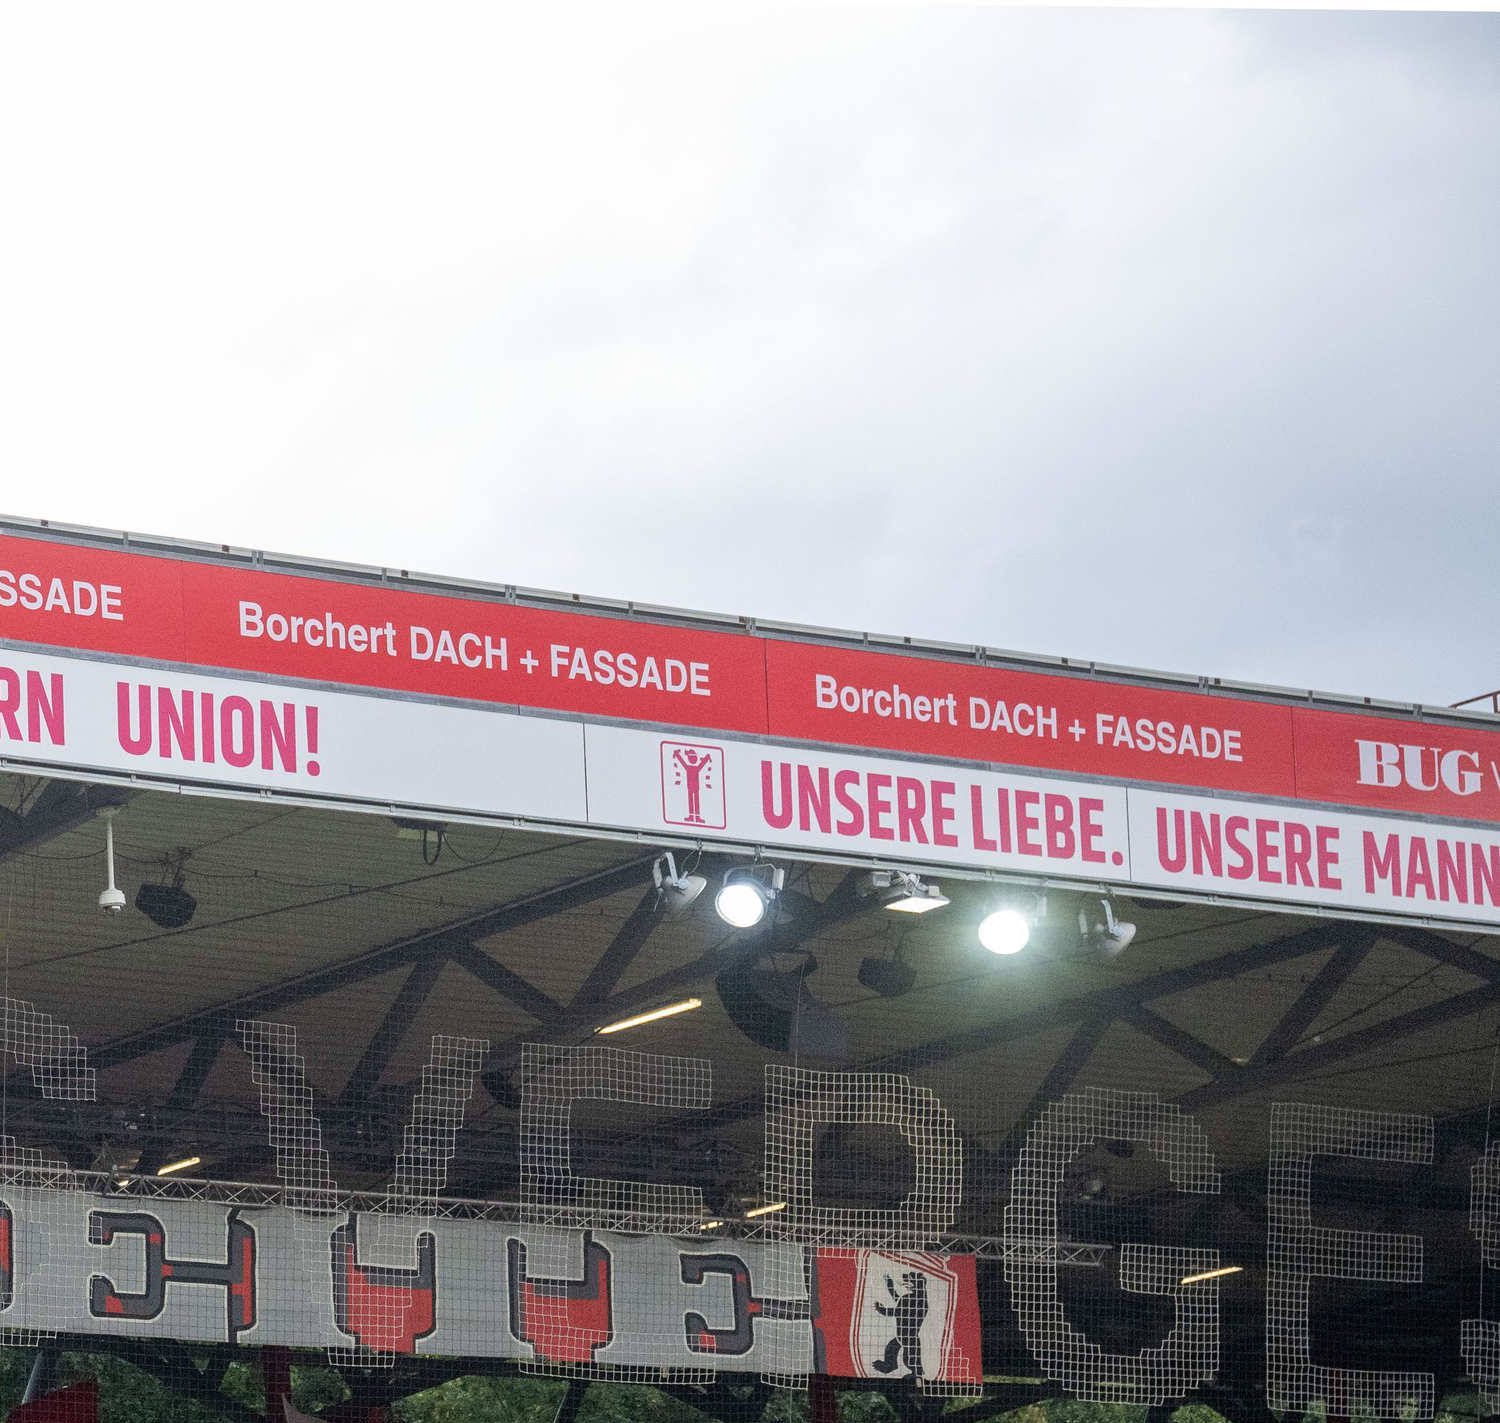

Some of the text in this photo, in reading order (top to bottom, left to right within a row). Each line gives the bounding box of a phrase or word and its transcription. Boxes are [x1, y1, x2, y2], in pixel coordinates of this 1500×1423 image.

[238, 600, 398, 658] Borchert
[409, 625, 508, 672] DACH
[549, 643, 712, 698] FASSADE
[115, 680, 322, 778] UNION!
[814, 672, 958, 728] Borchert
[968, 698, 1059, 742] DACH
[1096, 711, 1243, 763] FASSADE
[1354, 738, 1484, 797] BUG
[760, 758, 959, 849] UNSERE
[970, 785, 1125, 867] LIEBE.
[1156, 805, 1343, 891] UNSERE
[236, 1018, 1500, 1420] VERGE
